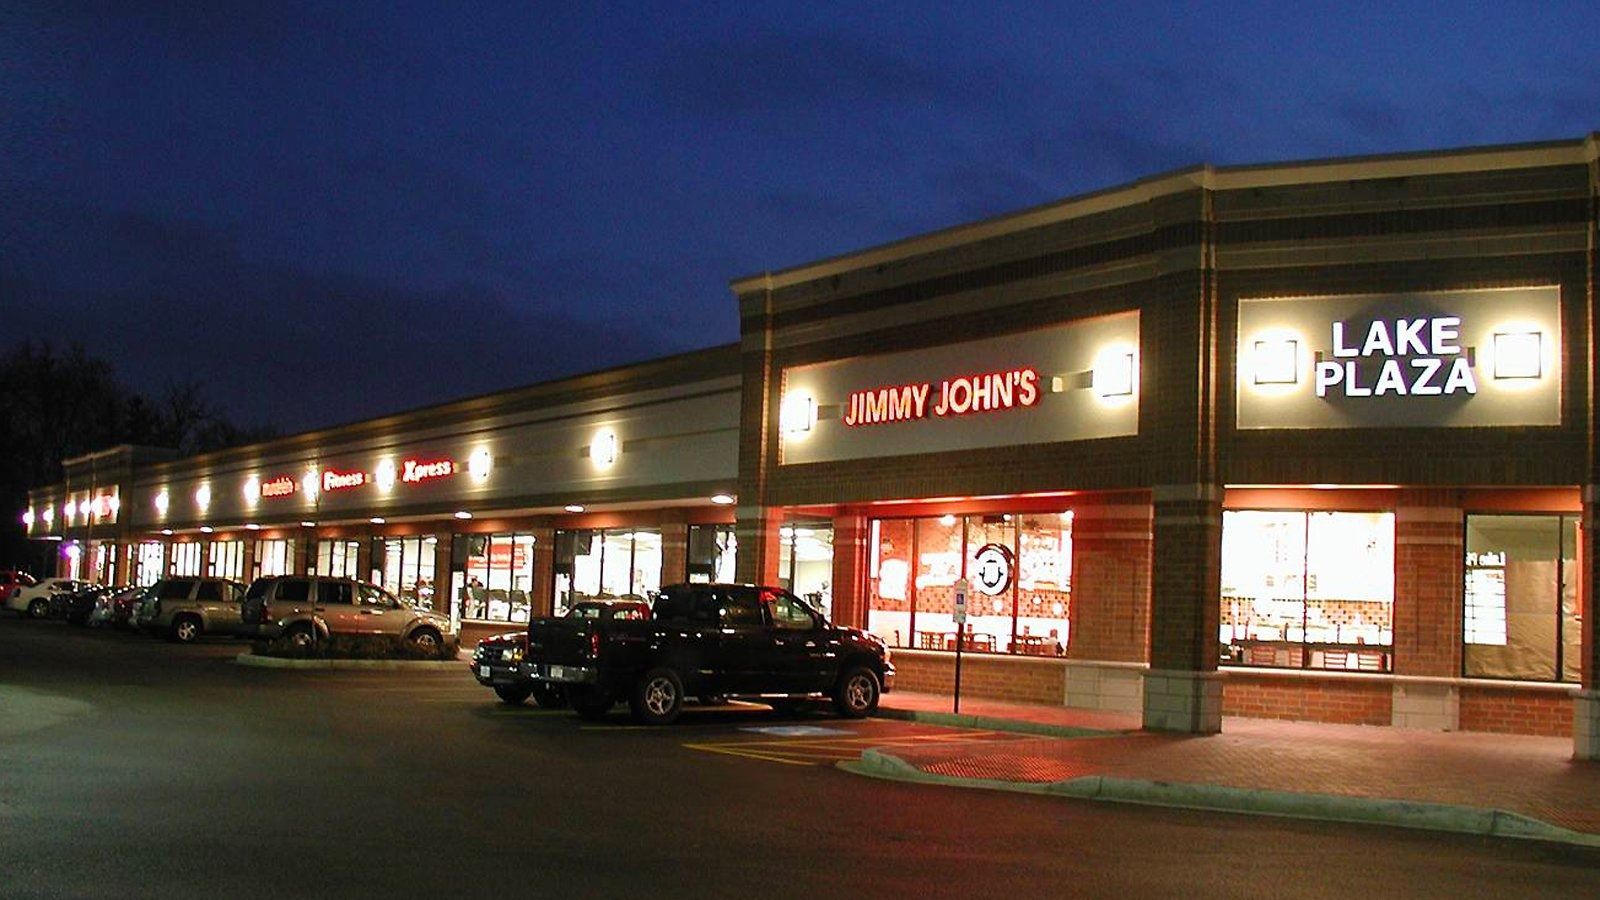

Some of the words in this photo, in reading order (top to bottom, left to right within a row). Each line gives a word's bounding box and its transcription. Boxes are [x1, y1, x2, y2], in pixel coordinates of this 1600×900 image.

[1331, 316, 1462, 358] LAKE
[845, 383, 930, 426] JIMMY
[935, 369, 1037, 416] JOHN'S
[1315, 357, 1478, 397] PLAZA
